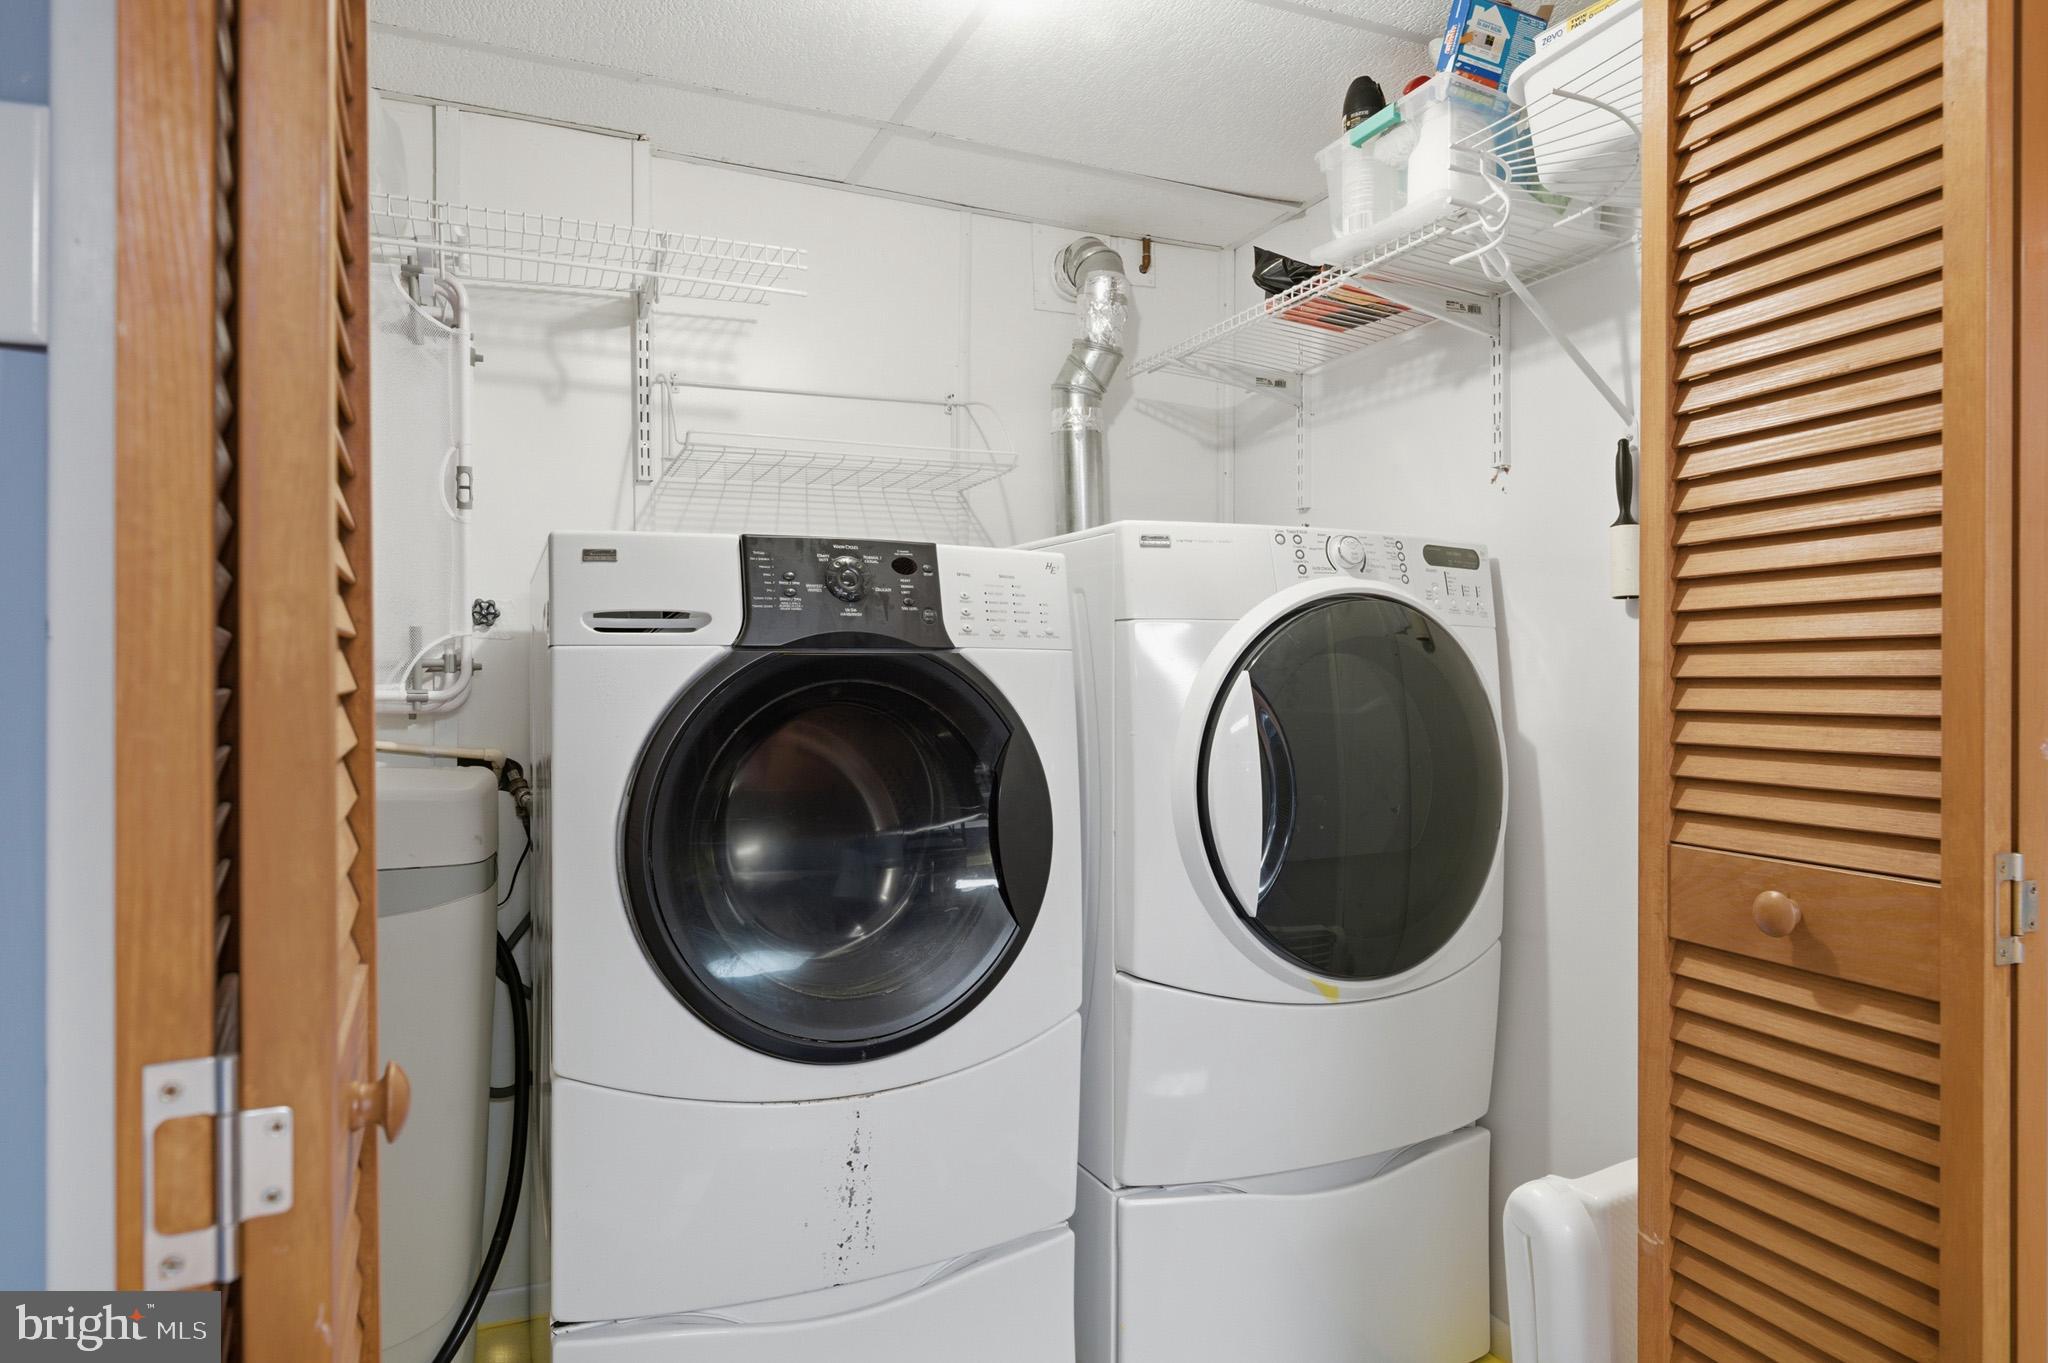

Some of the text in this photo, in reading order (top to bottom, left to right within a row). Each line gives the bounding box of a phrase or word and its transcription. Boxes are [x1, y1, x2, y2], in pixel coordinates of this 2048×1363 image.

[1571, 13, 1588, 24] TWIN
[1571, 19, 1587, 30] PACK
[1542, 29, 1563, 46] zevo
